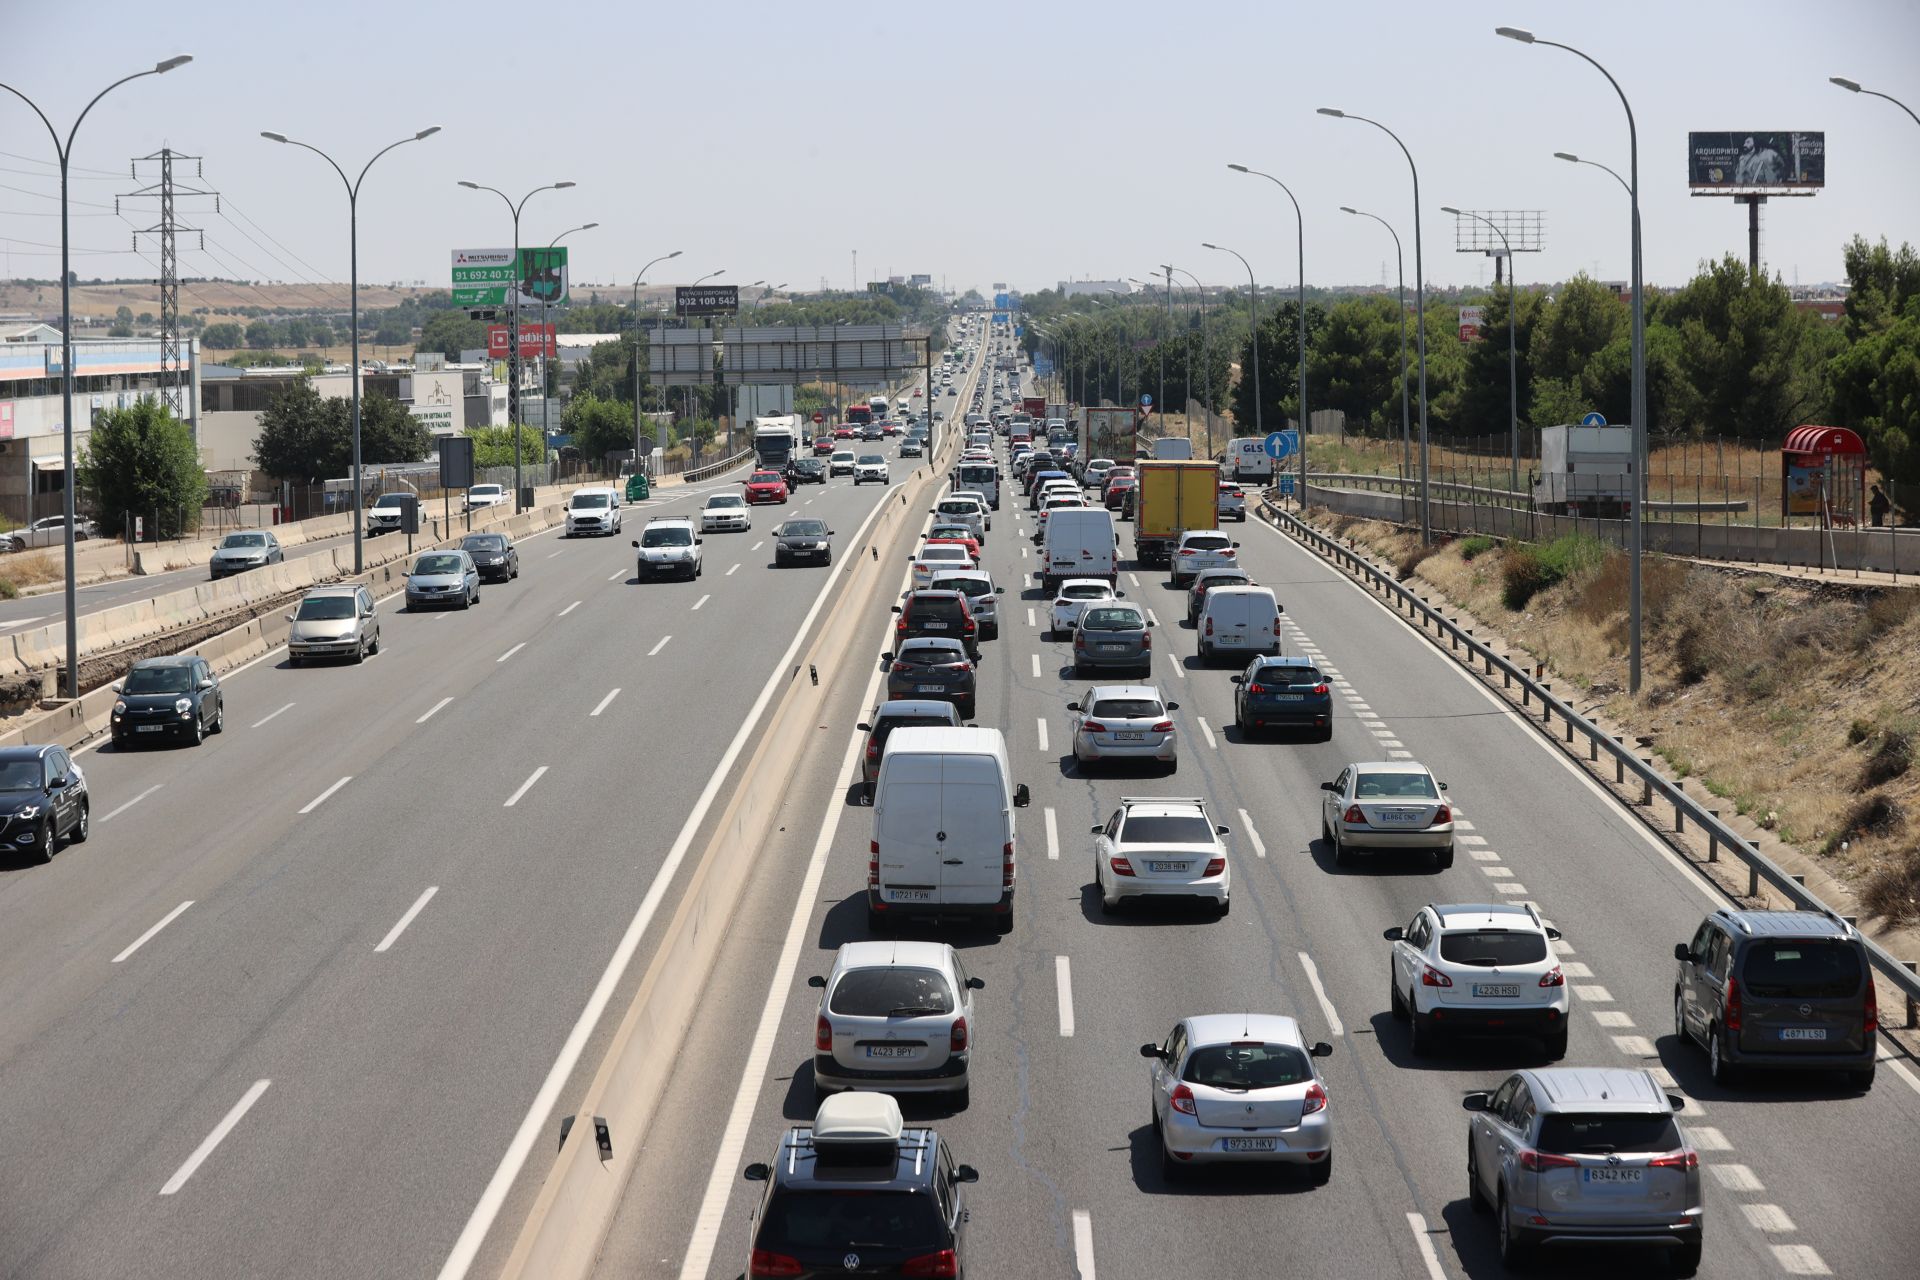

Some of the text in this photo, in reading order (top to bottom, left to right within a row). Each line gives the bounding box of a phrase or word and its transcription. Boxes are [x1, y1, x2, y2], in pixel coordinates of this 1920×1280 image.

[1695, 147, 1739, 155] ARQUEOPINTO
[456, 270, 516, 281] 91 692 40 72
[679, 296, 736, 306] 902 100 542
[1243, 444, 1264, 453] GLS
[896, 891, 929, 899] 0721 FVN
[1479, 986, 1518, 995] 4226 HSD
[872, 1047, 912, 1057] 4423 BPY
[1230, 1139, 1273, 1149] 9733 HKV
[1591, 1170, 1641, 1180] 6342 KFC
